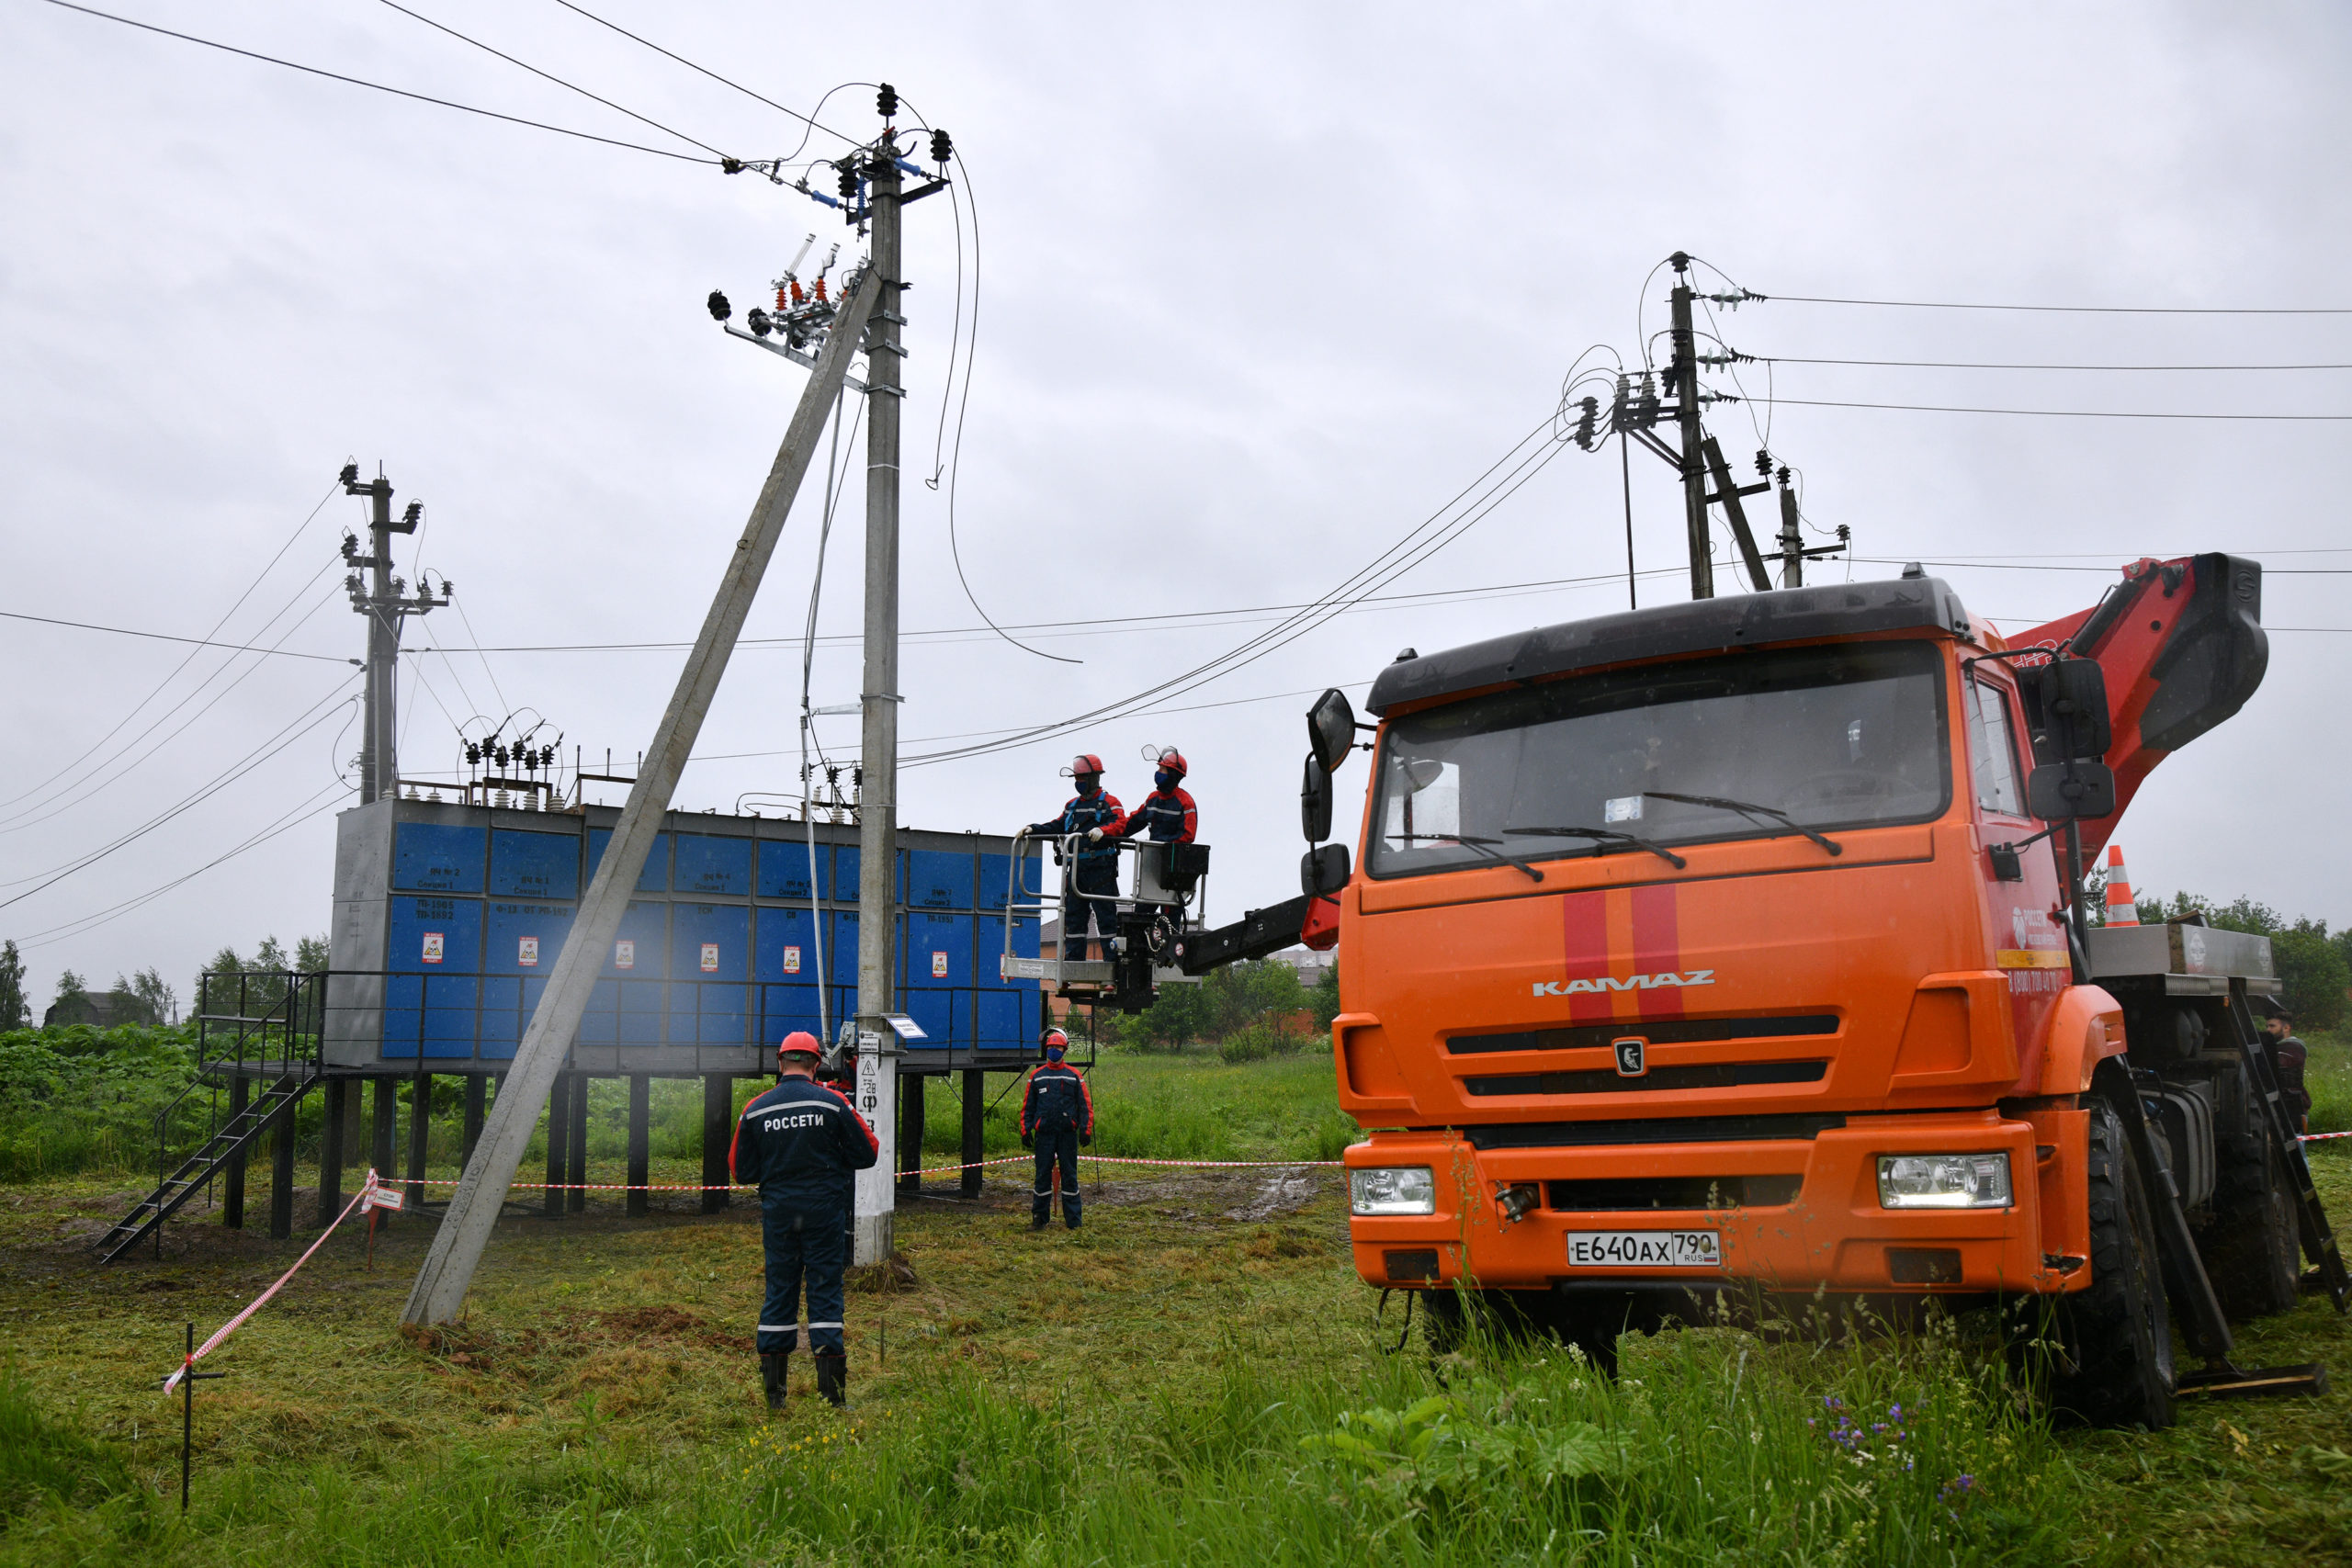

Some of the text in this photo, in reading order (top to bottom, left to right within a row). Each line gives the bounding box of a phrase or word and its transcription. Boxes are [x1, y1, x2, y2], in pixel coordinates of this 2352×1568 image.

[454, 868, 460, 876] 2
[544, 876, 549, 885] 1
[802, 889, 808, 897] 2
[1532, 969, 1715, 998] KAMAZ
[2007, 970, 2013, 992] 8
[764, 1113, 824, 1133] РОССЕТИ
[1576, 1236, 1670, 1261] Е640АХ
